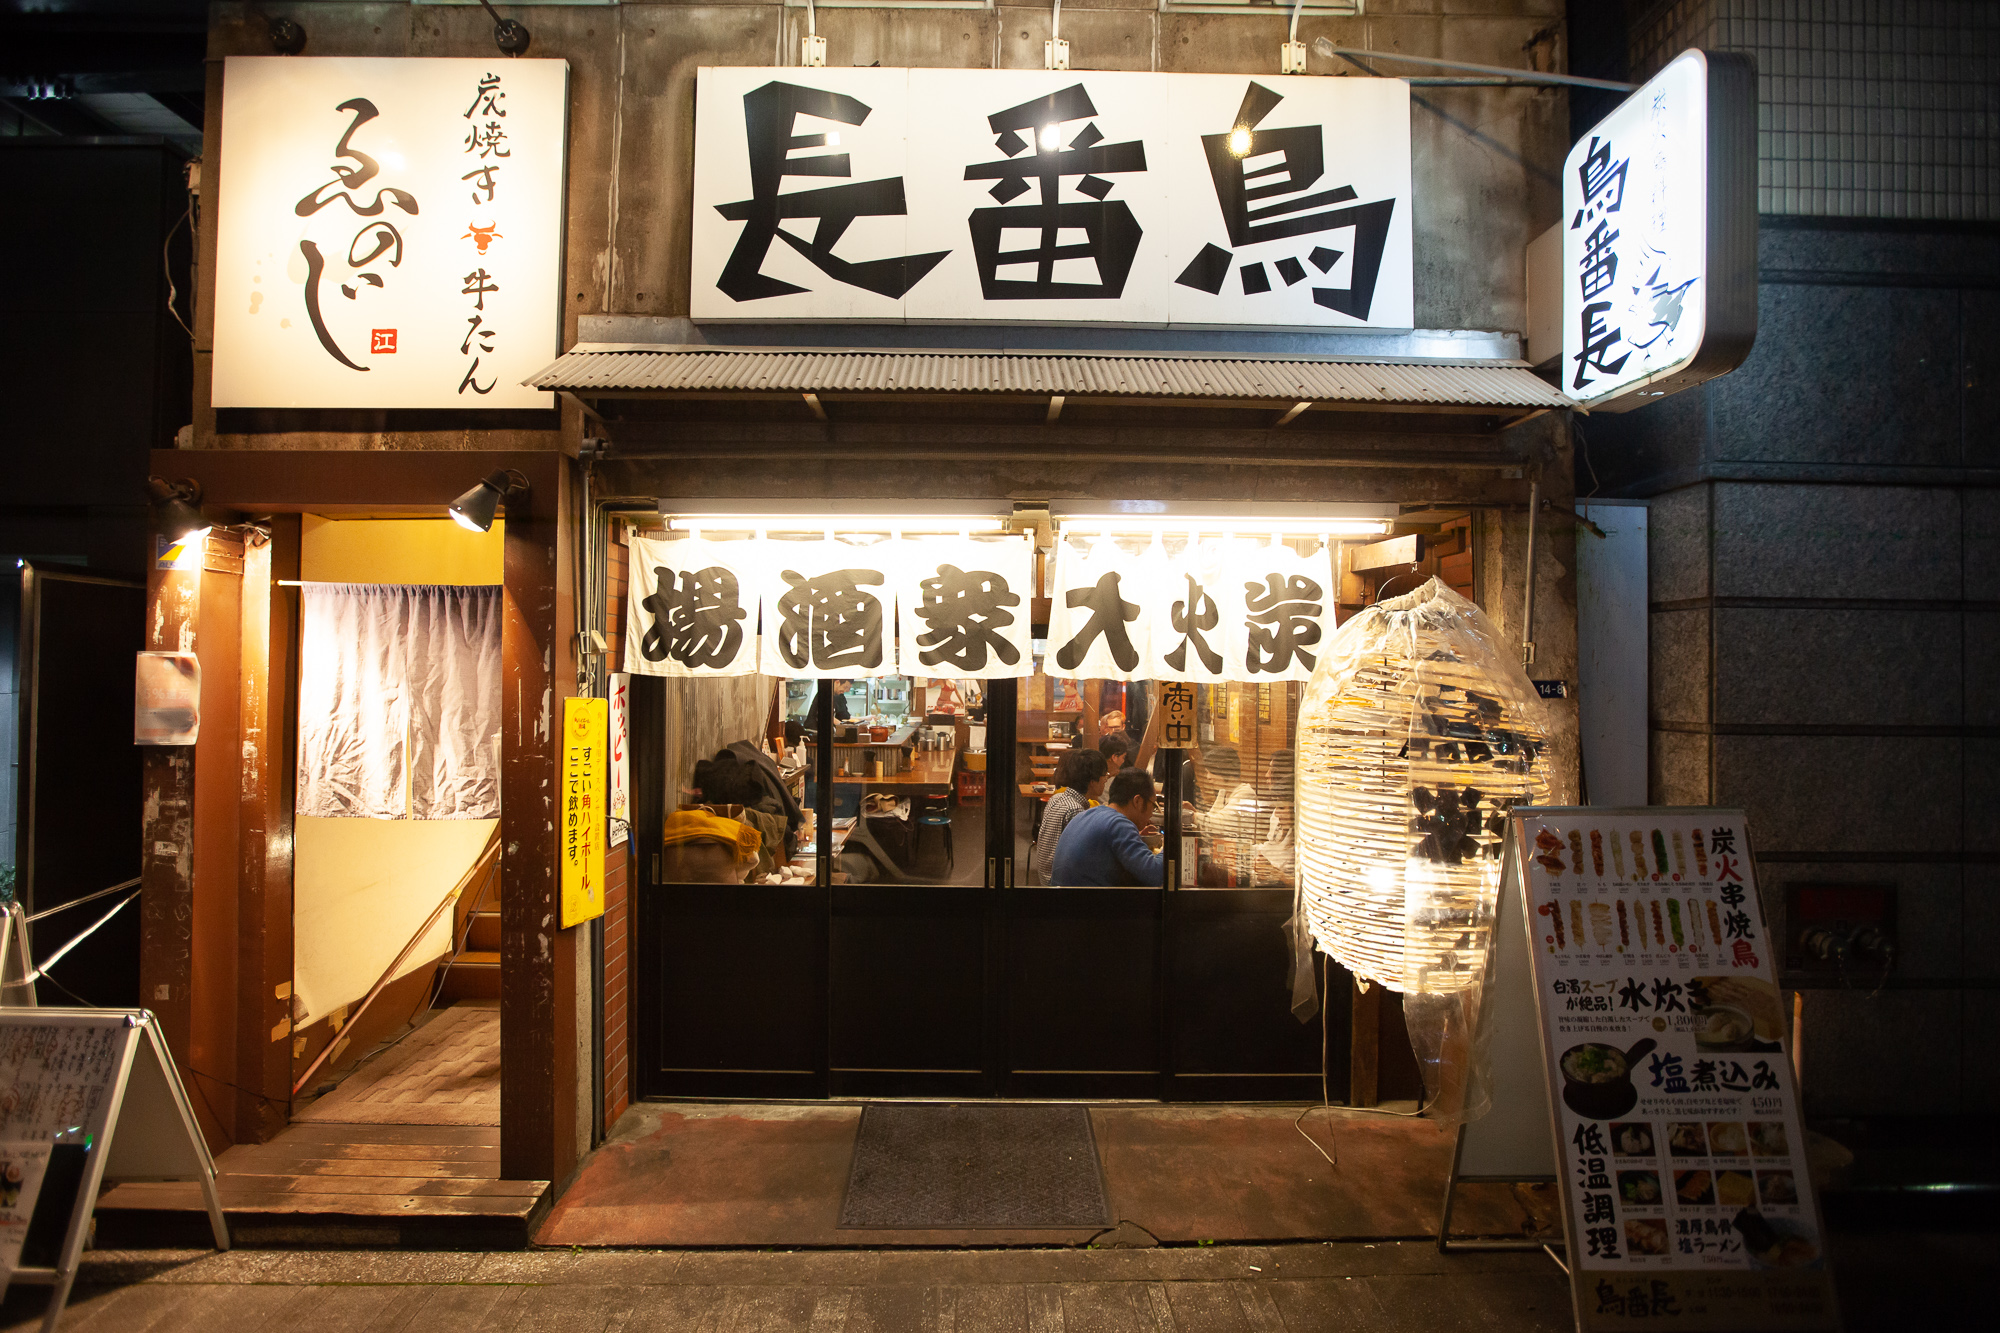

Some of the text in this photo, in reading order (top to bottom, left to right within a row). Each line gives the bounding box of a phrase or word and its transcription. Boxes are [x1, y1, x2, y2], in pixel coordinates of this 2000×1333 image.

[461, 73, 511, 205] 炭焼き
[295, 97, 419, 372] ゑのじ
[1570, 136, 1633, 390] 鳥番長
[374, 331, 396, 352] 江
[458, 267, 499, 395] 牛たん
[613, 684, 628, 789] ホッピー
[1539, 684, 1563, 695] 14-8
[567, 747, 579, 867] ここで飲めます。
[580, 746, 593, 891] すごい角ハイボール
[1711, 826, 1760, 969] 炭火串焼鳥
[1553, 978, 1619, 995] 白濁スープ
[1618, 976, 1711, 1013] 水炊き
[1648, 1052, 1780, 1094] 塩煮込み
[1573, 1122, 1622, 1260] 低温調理
[1678, 1237, 1742, 1254] 塩ラーメン
[1595, 1277, 1682, 1318] 鳥番長
